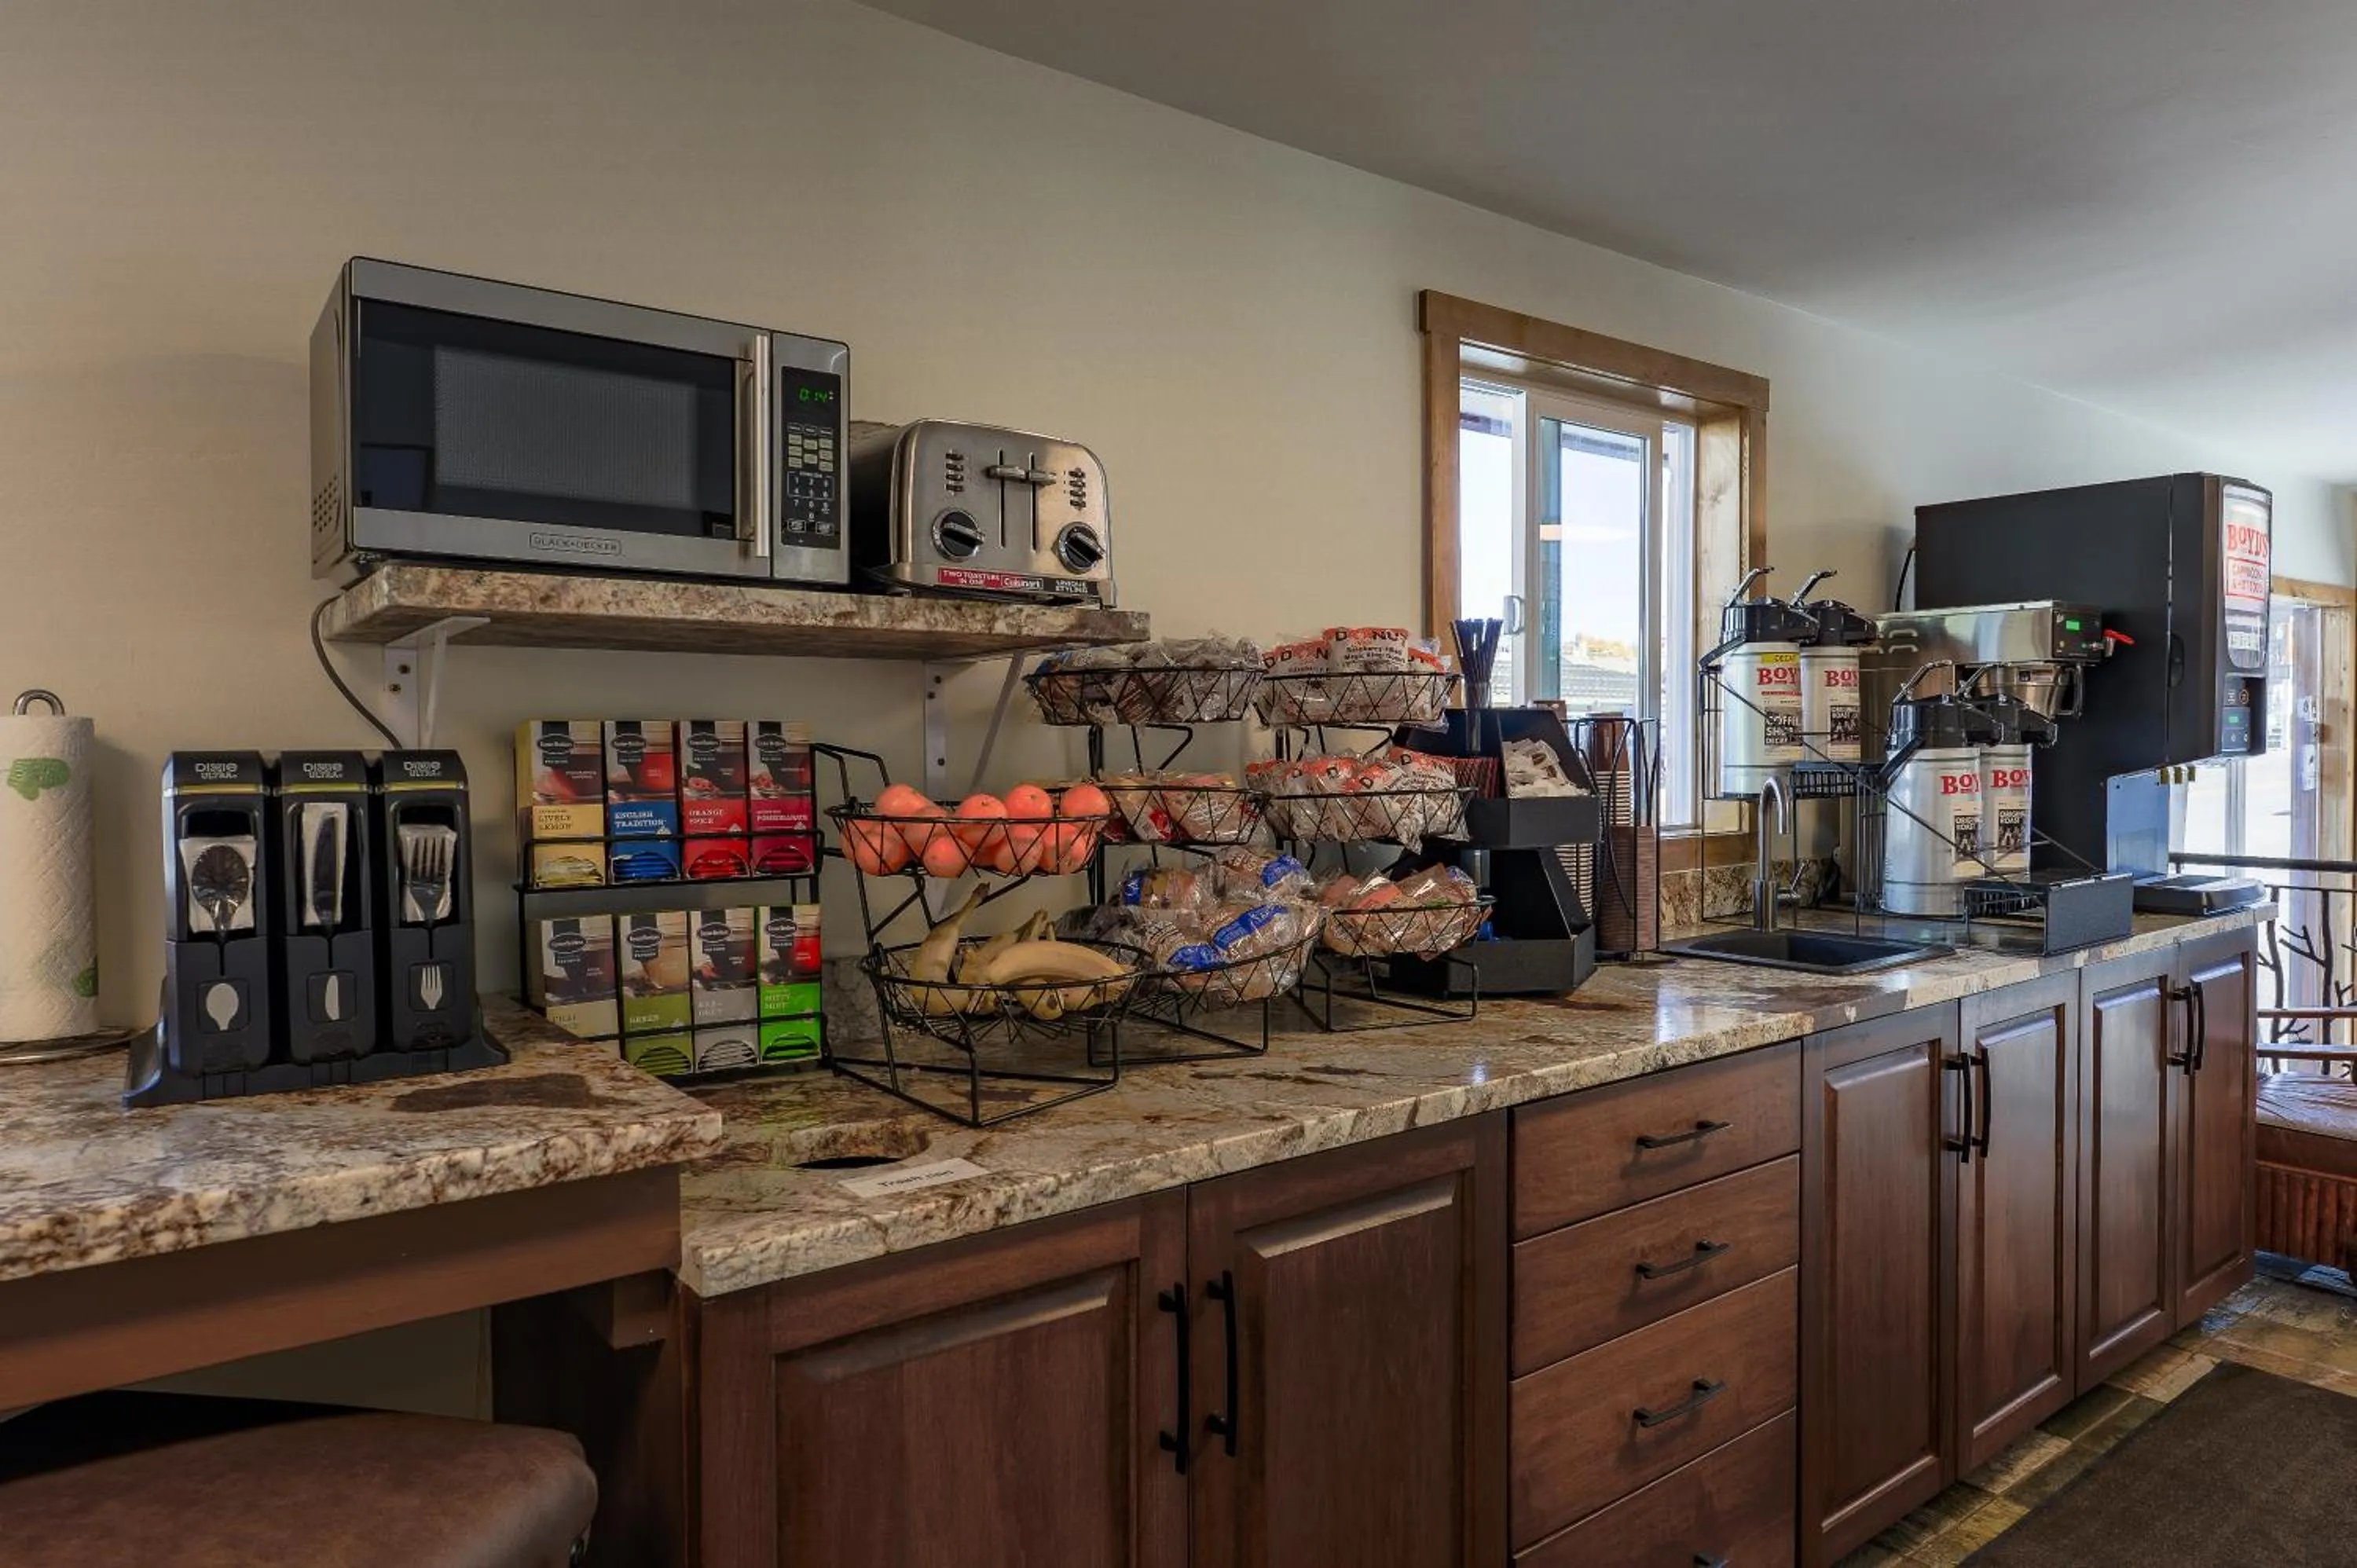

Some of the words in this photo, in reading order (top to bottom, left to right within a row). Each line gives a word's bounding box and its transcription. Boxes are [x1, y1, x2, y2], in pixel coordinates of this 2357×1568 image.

[963, 571, 1001, 581] TOASTERS
[194, 762, 238, 773] DIXIE
[614, 811, 654, 819] ENGLISH
[614, 819, 665, 828] TRADITION
